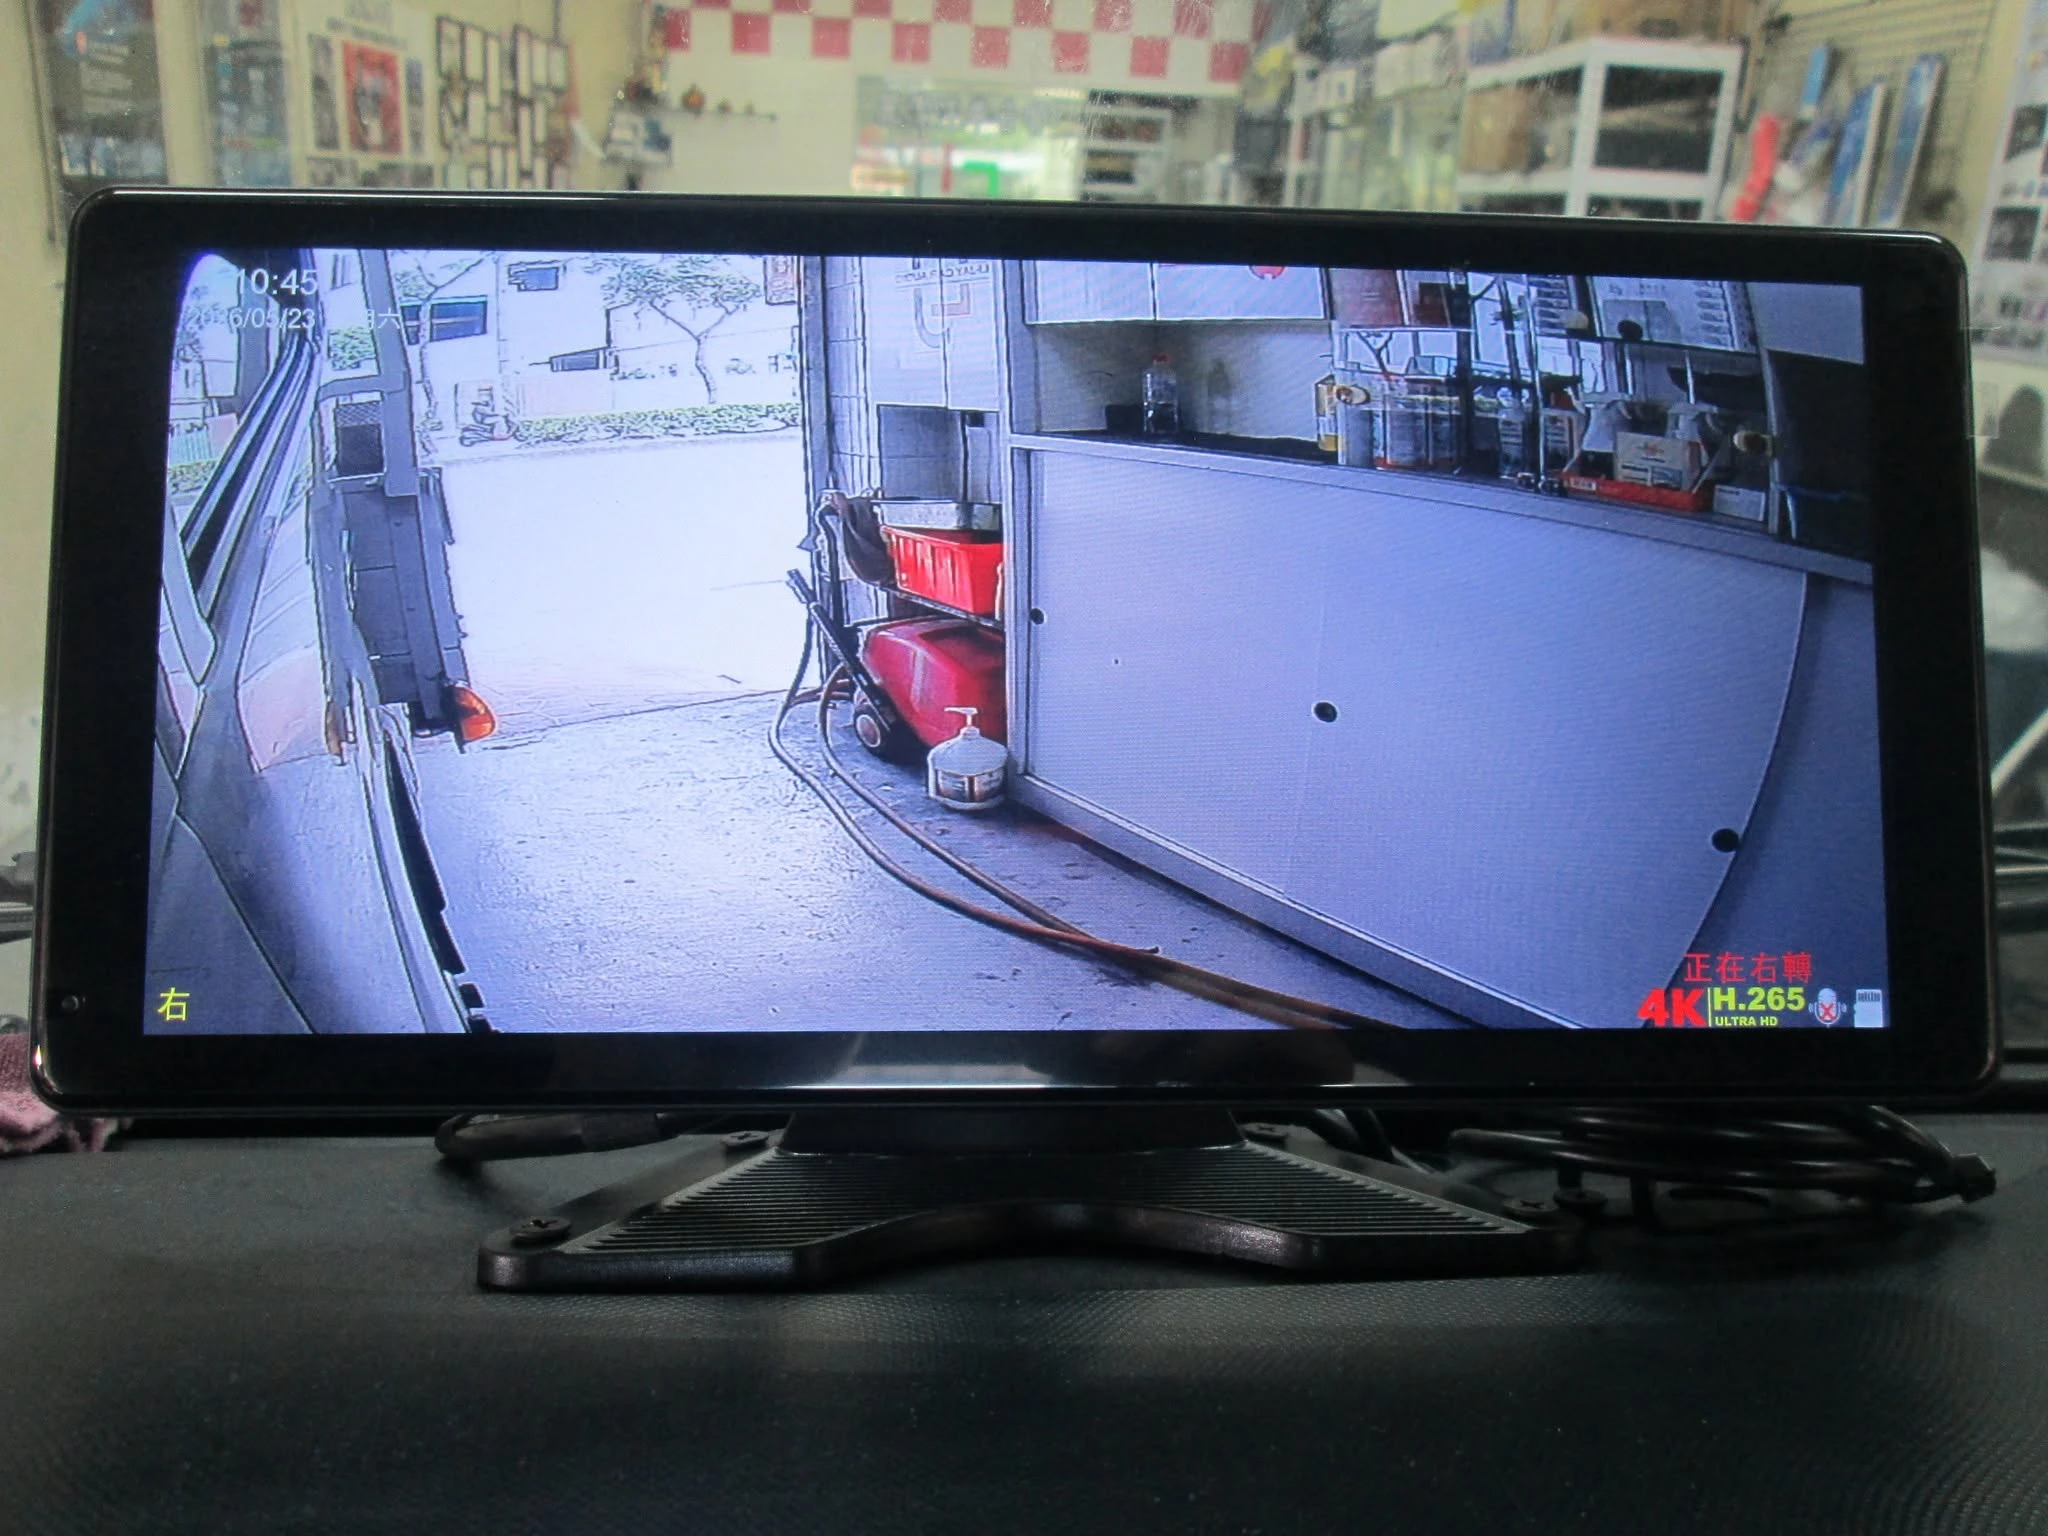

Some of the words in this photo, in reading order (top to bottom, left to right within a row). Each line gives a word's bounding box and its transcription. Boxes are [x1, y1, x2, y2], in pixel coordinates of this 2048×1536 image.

[238, 268, 318, 294] 10:45
[1683, 951, 1813, 984] 正在右轉
[157, 986, 191, 1021] 右
[1637, 987, 1707, 1027] 4K
[1713, 986, 1806, 1011] H.265
[1715, 1015, 1757, 1027] ULTRA
[1760, 1015, 1779, 1027] HD
